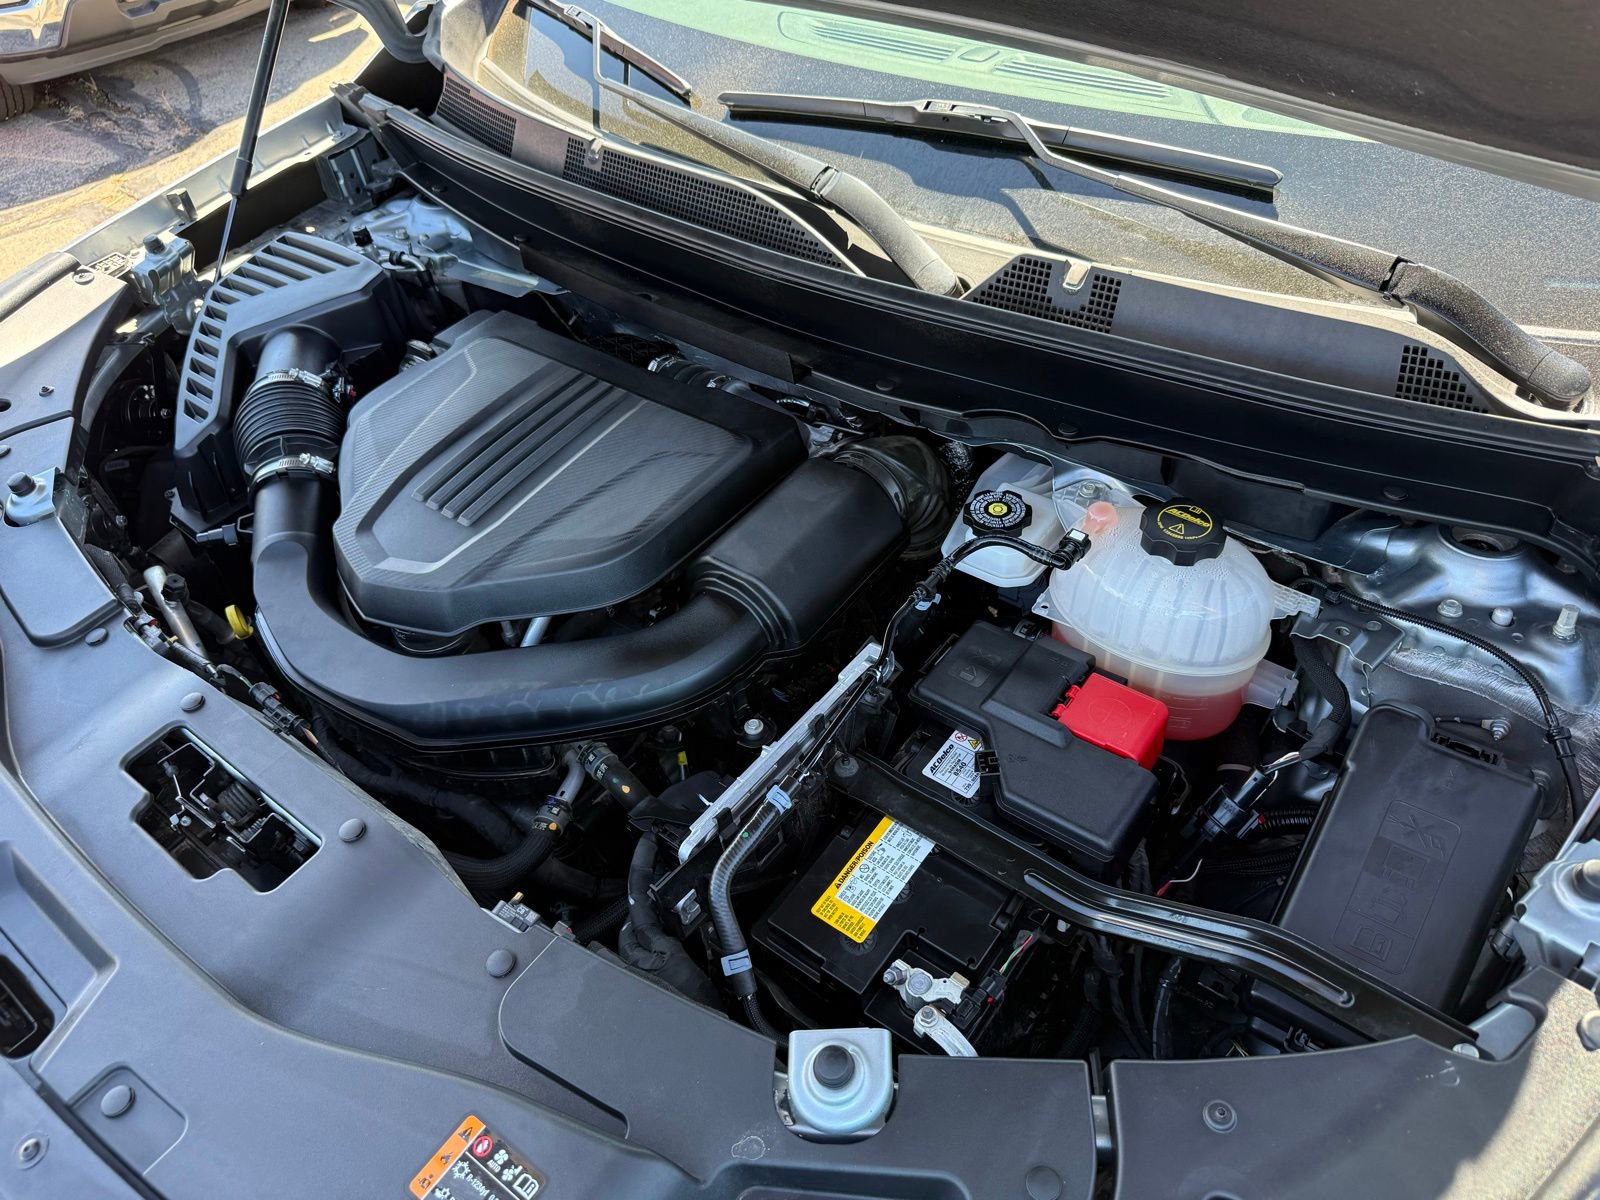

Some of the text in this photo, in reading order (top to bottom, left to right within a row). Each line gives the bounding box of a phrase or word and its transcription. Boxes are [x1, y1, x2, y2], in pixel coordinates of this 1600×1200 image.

[1165, 508, 1211, 528] ACDelco
[929, 743, 954, 774] ACDelco
[838, 840, 874, 886] DANGER/POISON
[486, 1159, 501, 1172] AUTO
[465, 1173, 490, 1197] R-1234yf
